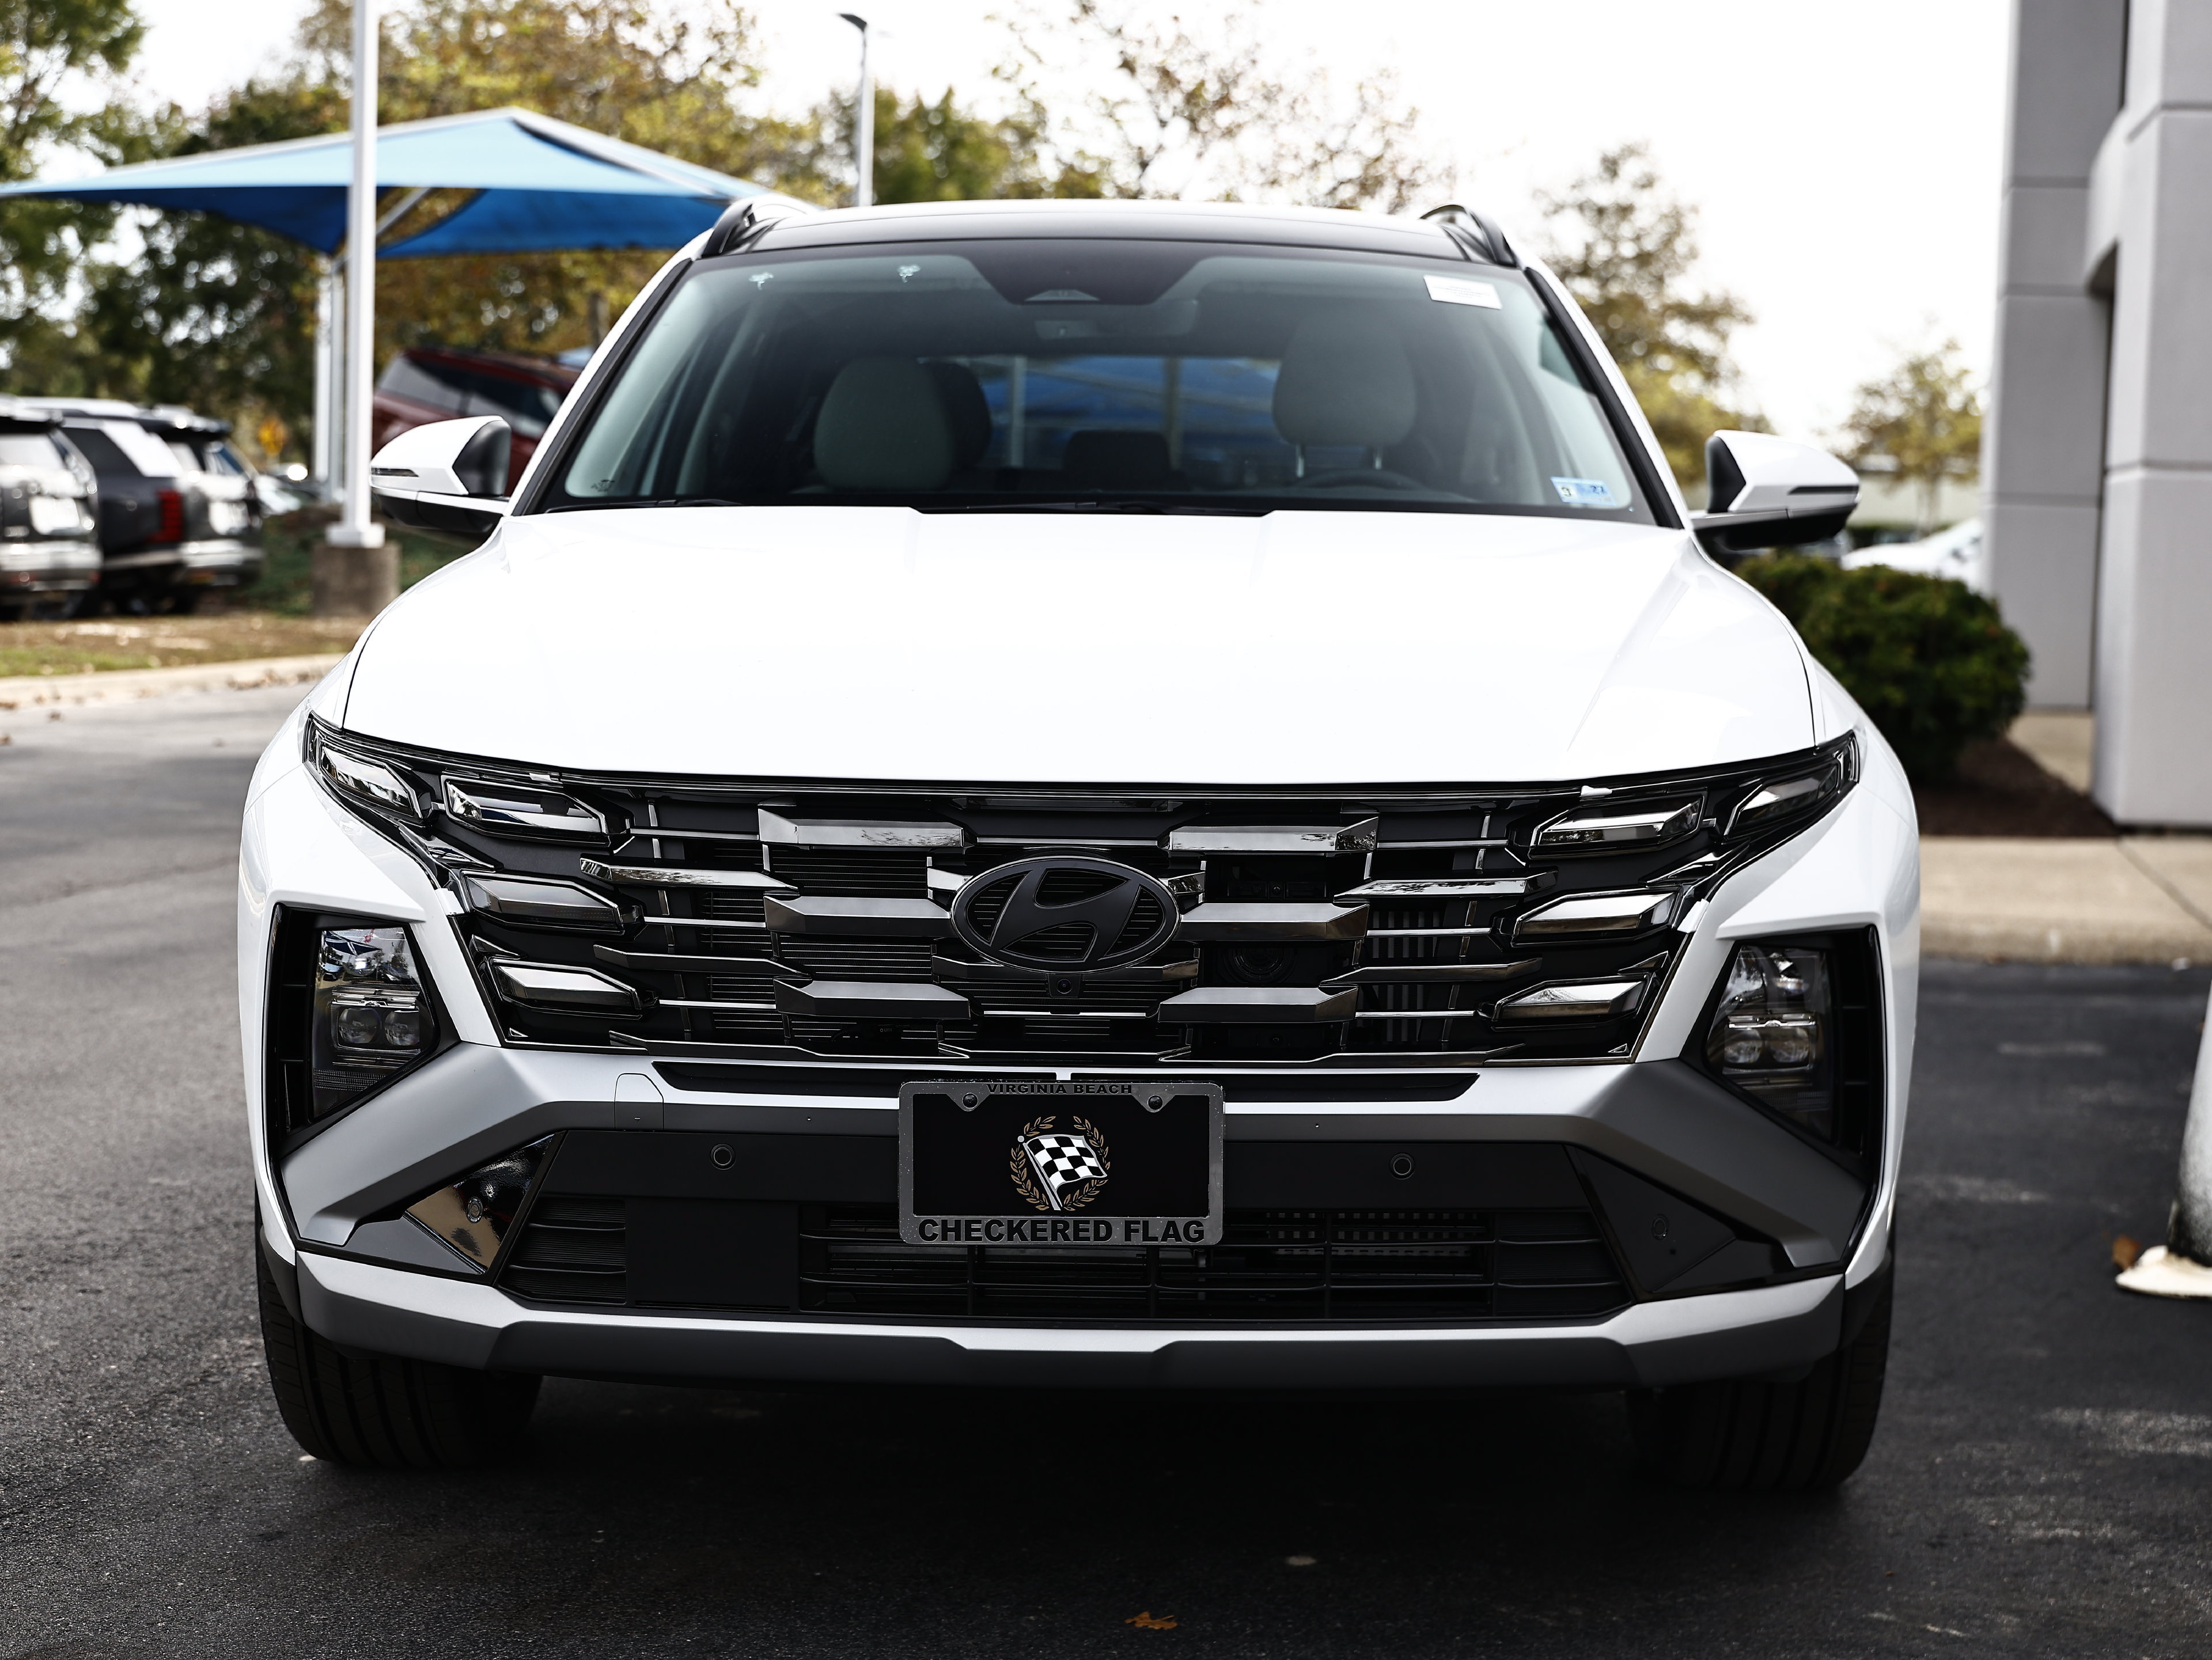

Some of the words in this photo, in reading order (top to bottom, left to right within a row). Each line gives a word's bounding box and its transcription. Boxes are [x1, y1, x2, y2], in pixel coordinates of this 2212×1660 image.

[987, 1084, 1067, 1094] VIRGINIA
[1073, 1084, 1132, 1094] BEACH
[918, 1219, 1112, 1242] CHECKERED
[1124, 1220, 1205, 1242] FLAG
